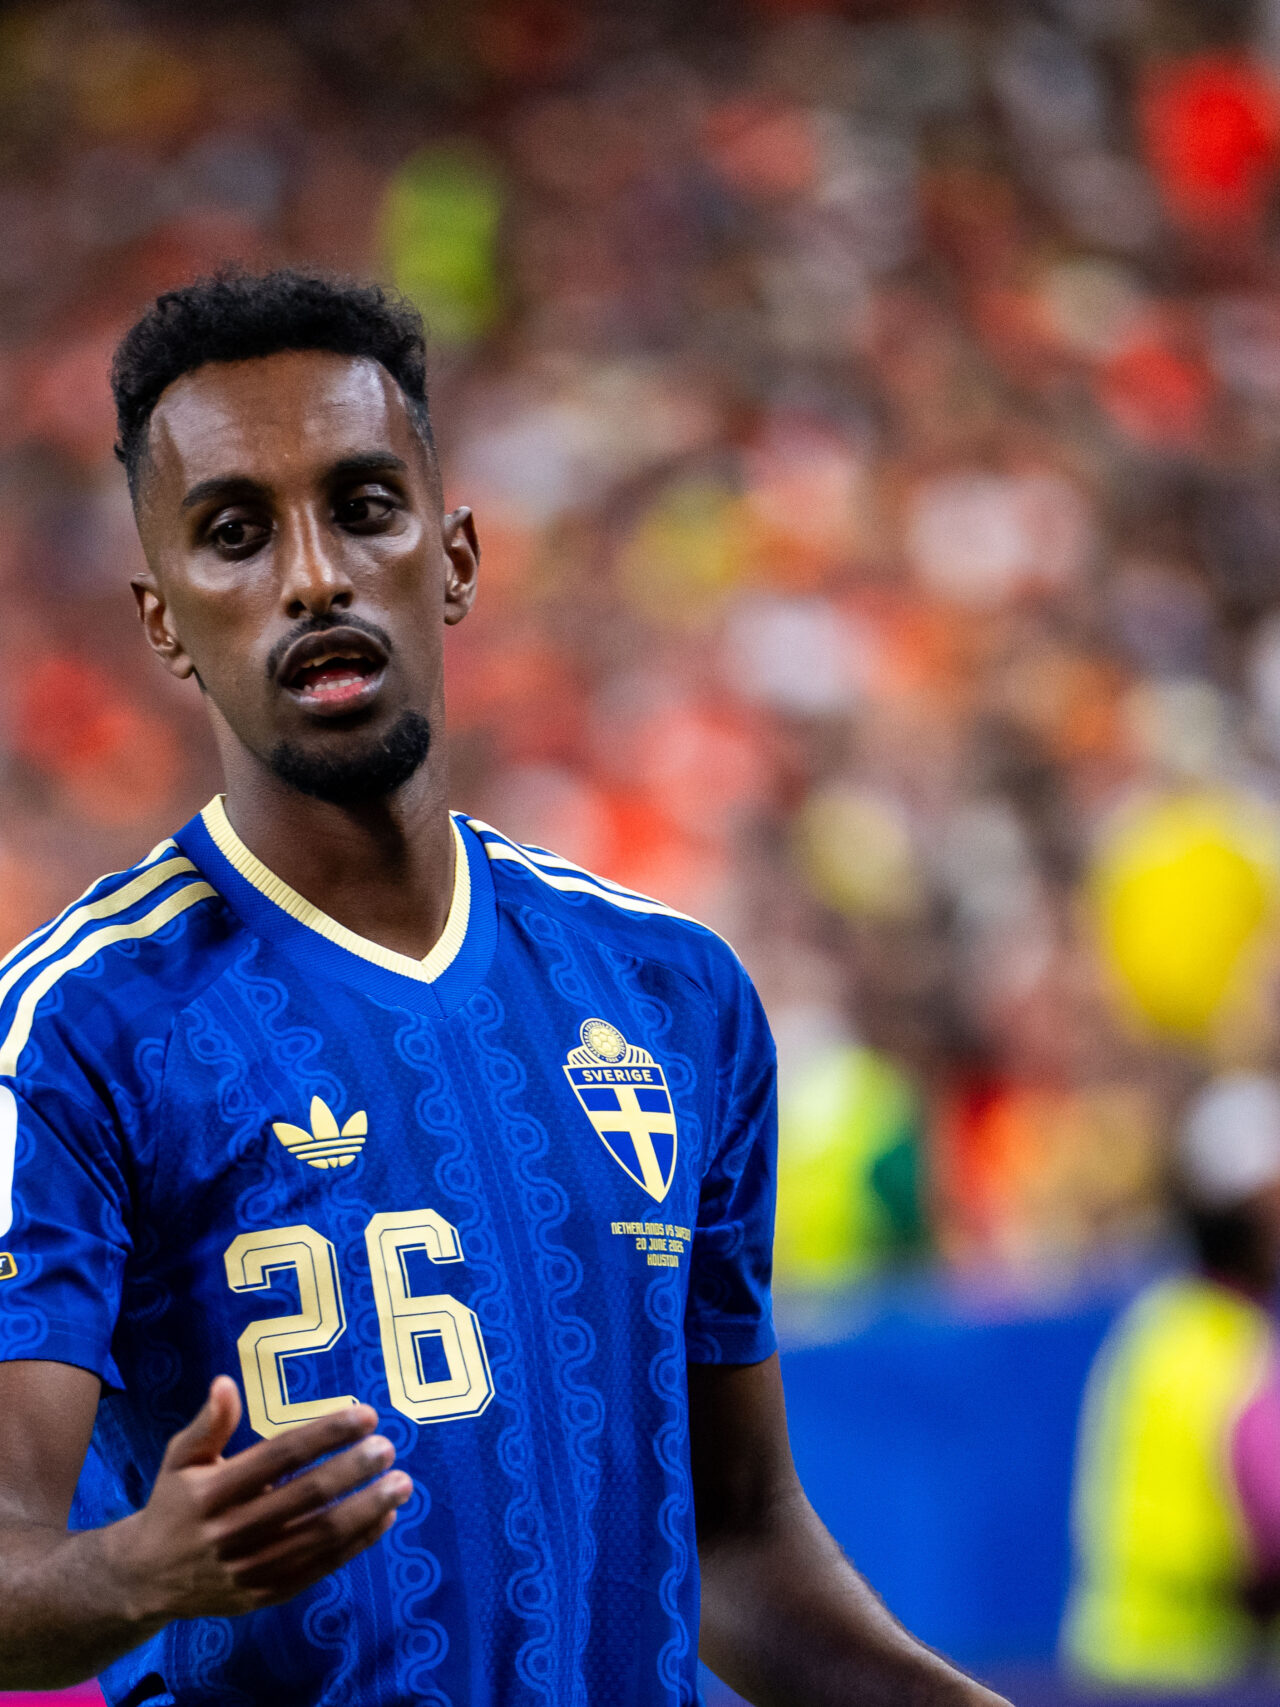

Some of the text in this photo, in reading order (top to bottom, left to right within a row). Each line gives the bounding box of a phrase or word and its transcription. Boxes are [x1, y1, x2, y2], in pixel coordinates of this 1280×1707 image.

[581, 1069, 654, 1083] SVERIGE
[611, 1222, 665, 1236] NETHERLANDS
[635, 1237, 647, 1250] 20
[648, 1237, 668, 1251] JUNE
[647, 1253, 679, 1268] HOUSTON
[223, 1208, 496, 1441] 26
